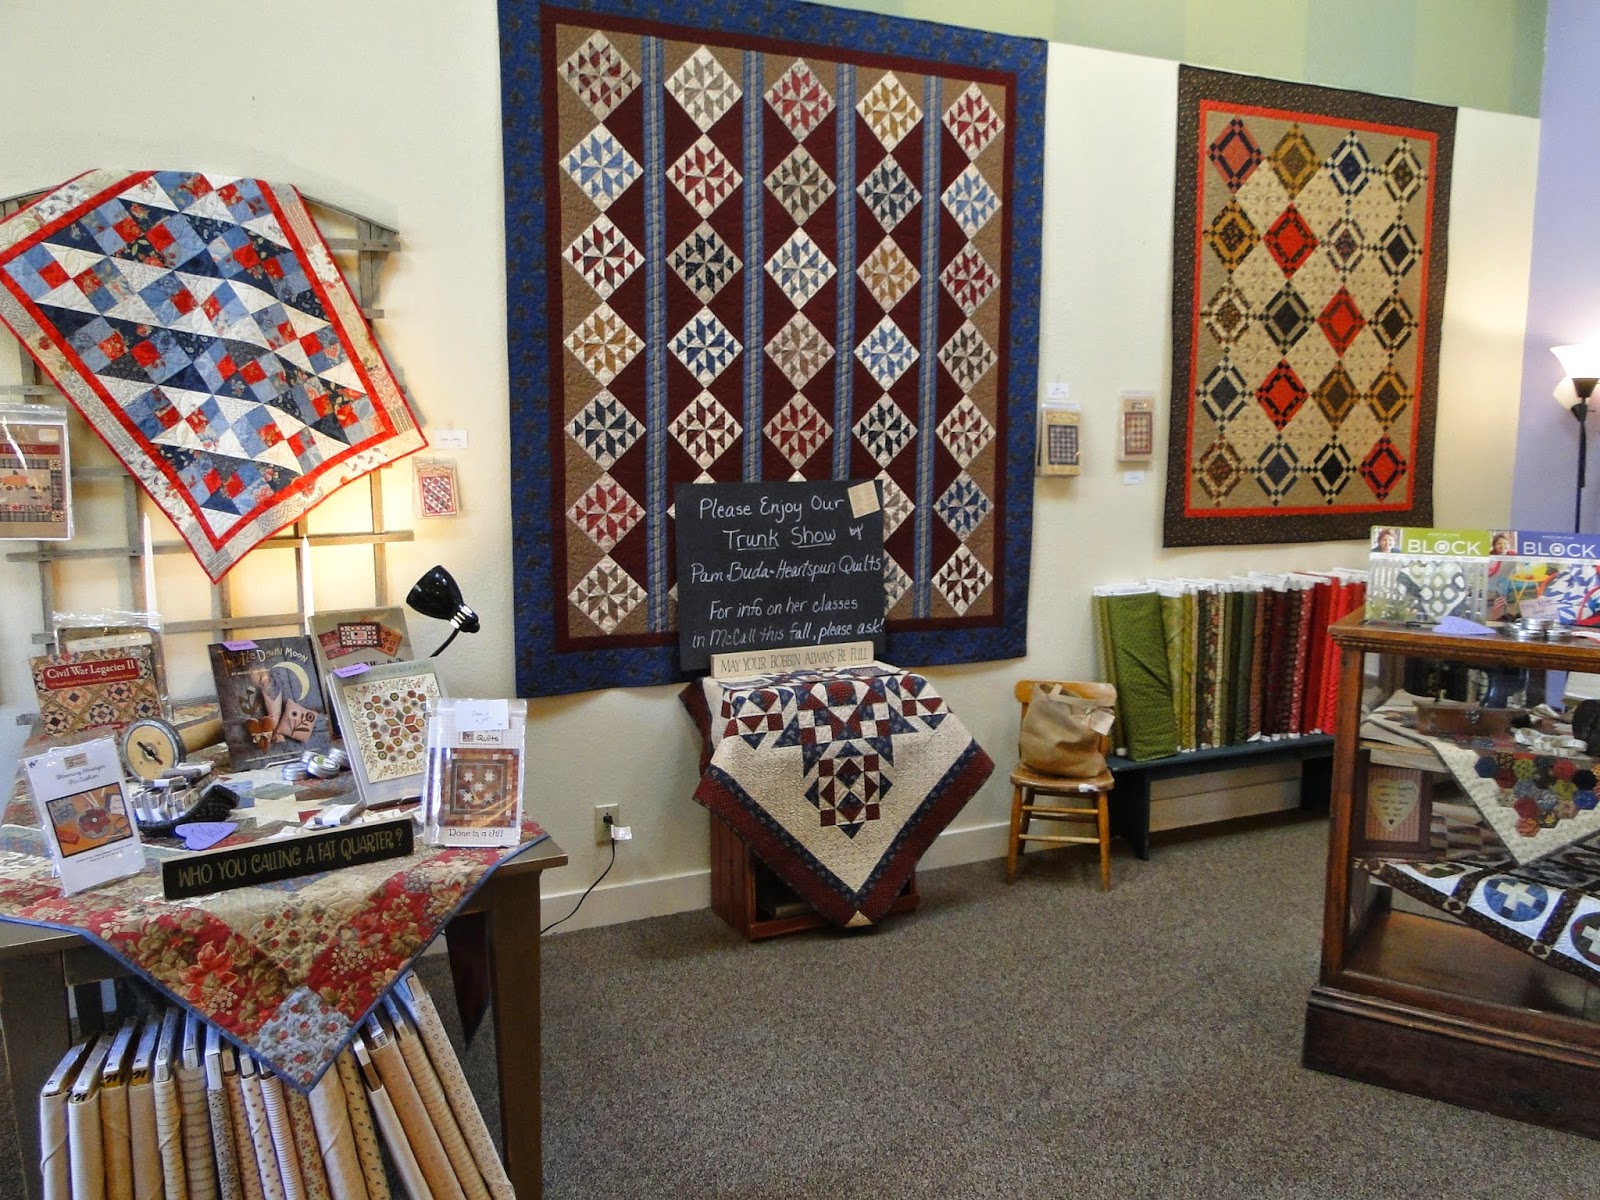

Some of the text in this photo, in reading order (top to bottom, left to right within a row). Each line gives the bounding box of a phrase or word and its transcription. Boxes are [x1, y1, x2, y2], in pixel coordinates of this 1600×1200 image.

[700, 496, 845, 523] Please Enjoy Our
[722, 524, 864, 549] Trunk Show by
[1407, 539, 1481, 556] BLOCK
[1523, 541, 1597, 559] BLOCK
[691, 563, 723, 584] Pam
[838, 554, 882, 575] Quilts
[709, 593, 858, 620] For info on her classes
[692, 633, 706, 648] in
[709, 628, 756, 647] McCall
[760, 625, 784, 643] this
[817, 621, 852, 644] please
[857, 618, 885, 633] ask!
[46, 659, 135, 679] Civil War Legacies II
[721, 647, 868, 673] MAY YOUR BOBBIN ALWAYS BE FULL
[477, 734, 500, 742] Quilts
[448, 828, 471, 837] Done
[178, 864, 213, 888] WHO
[217, 858, 247, 880] YOU
[251, 847, 301, 874] CALLING
[306, 845, 315, 864] A
[318, 840, 336, 862] FAT
